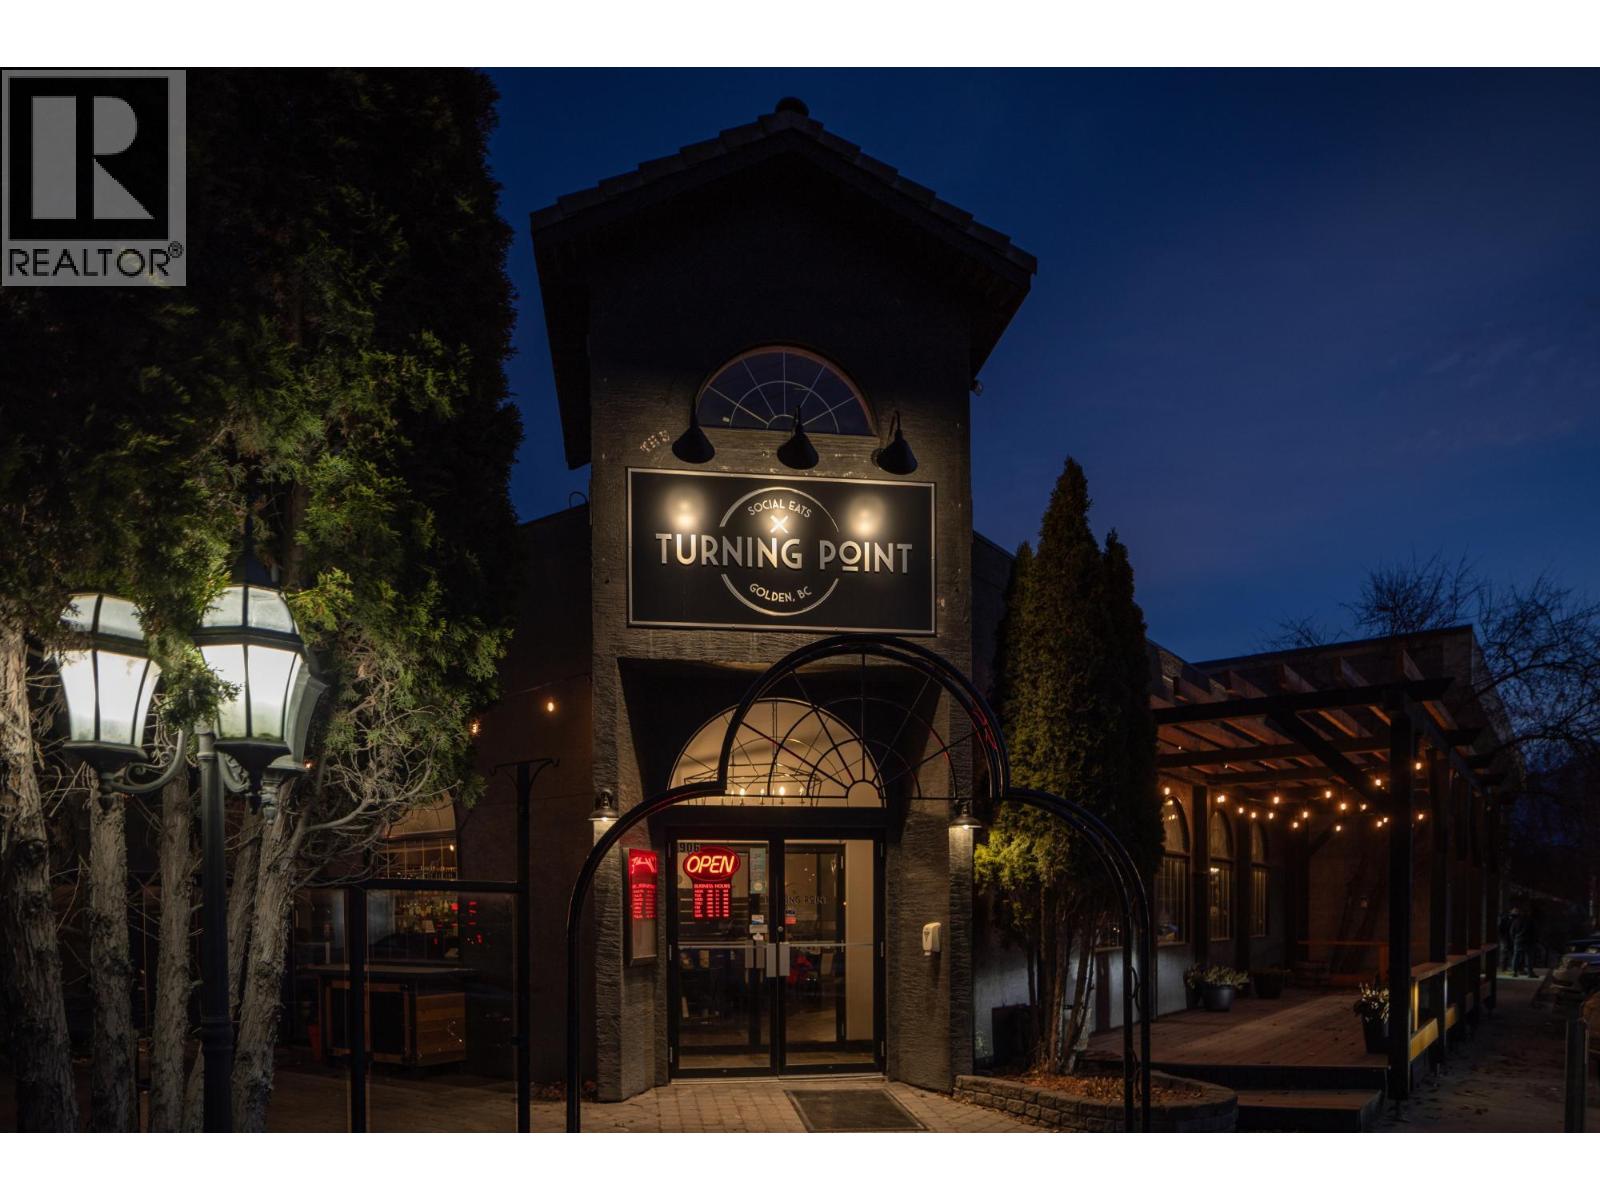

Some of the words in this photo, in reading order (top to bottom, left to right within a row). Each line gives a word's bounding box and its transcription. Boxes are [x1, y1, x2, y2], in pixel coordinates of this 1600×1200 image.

[746, 499, 786, 517] SOCIAL
[788, 500, 812, 518] EATS
[655, 533, 803, 570] TURNING
[819, 540, 913, 574] POINT
[749, 582, 796, 603] GOLDEN,
[797, 586, 812, 599] BC
[686, 855, 735, 874] OPEN
